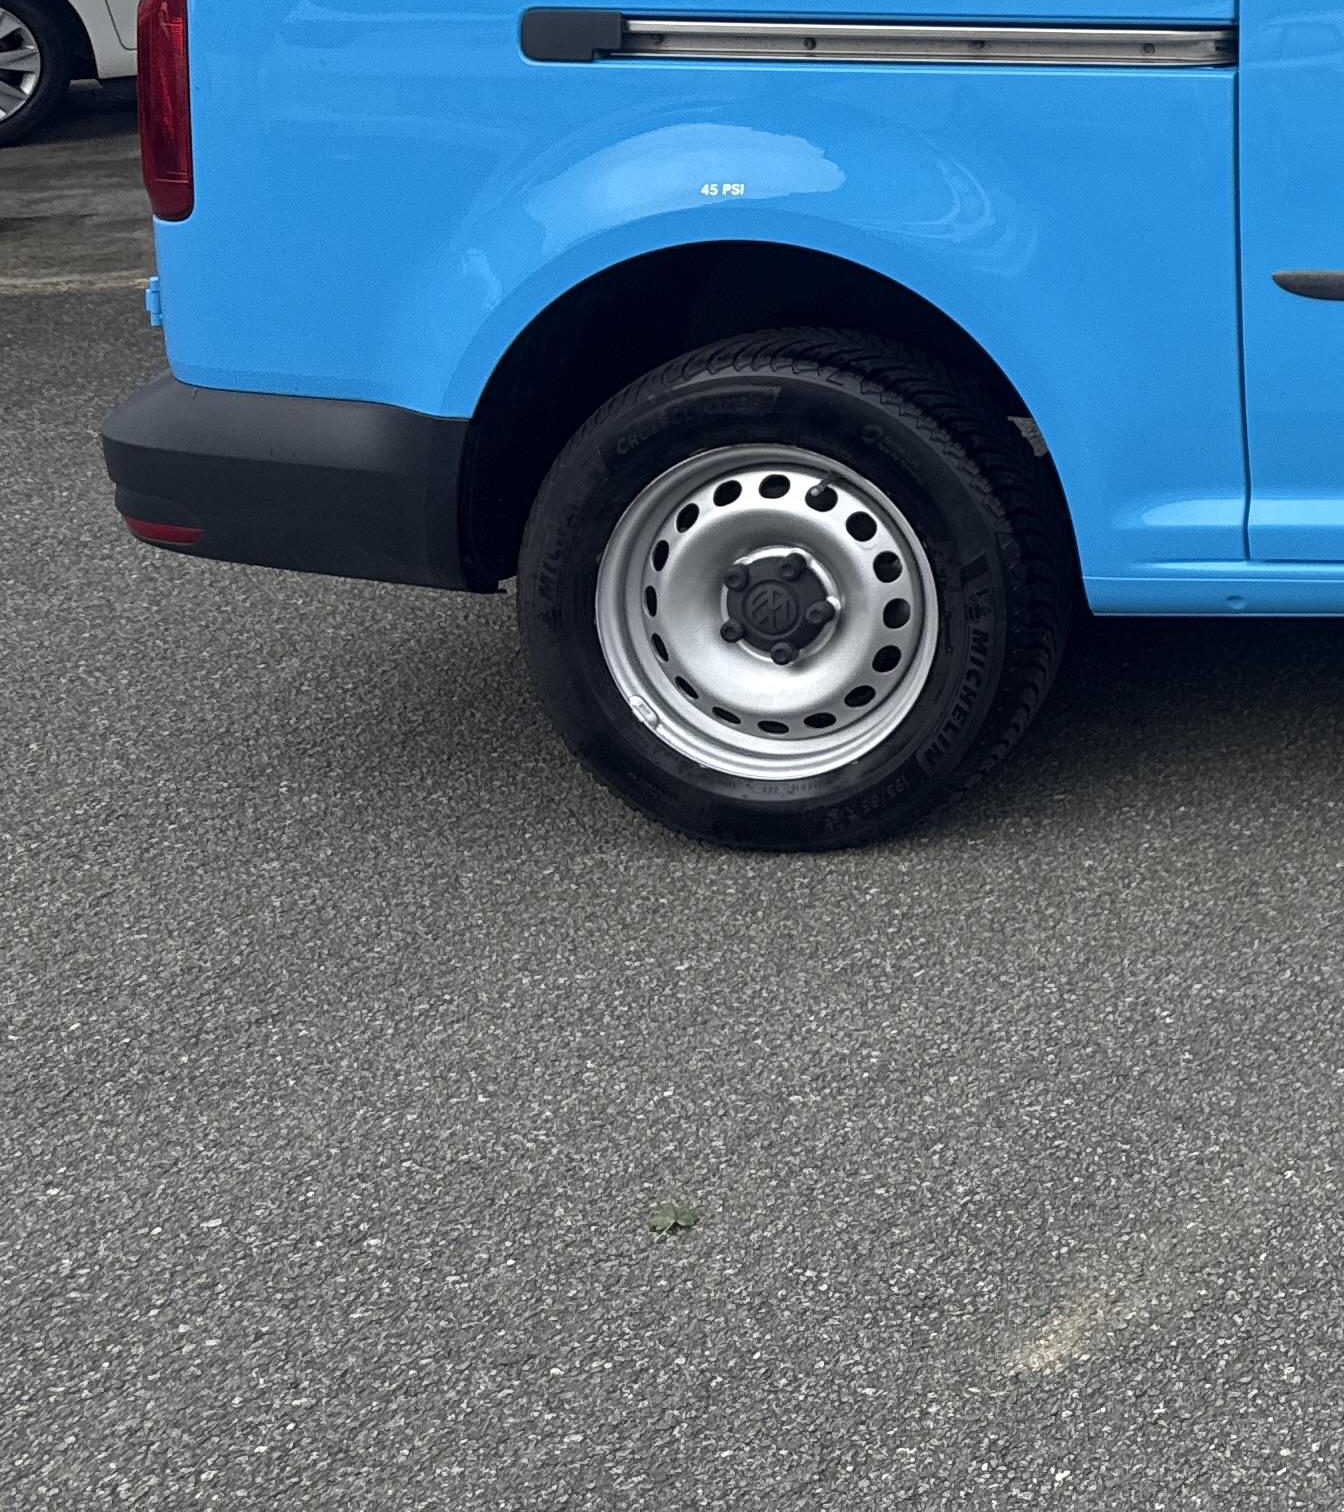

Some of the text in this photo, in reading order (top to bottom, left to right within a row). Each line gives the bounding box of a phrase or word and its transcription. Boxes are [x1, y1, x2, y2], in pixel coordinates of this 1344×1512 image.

[700, 183, 745, 196] 45 PSI
[924, 627, 991, 767] MICHELIN
